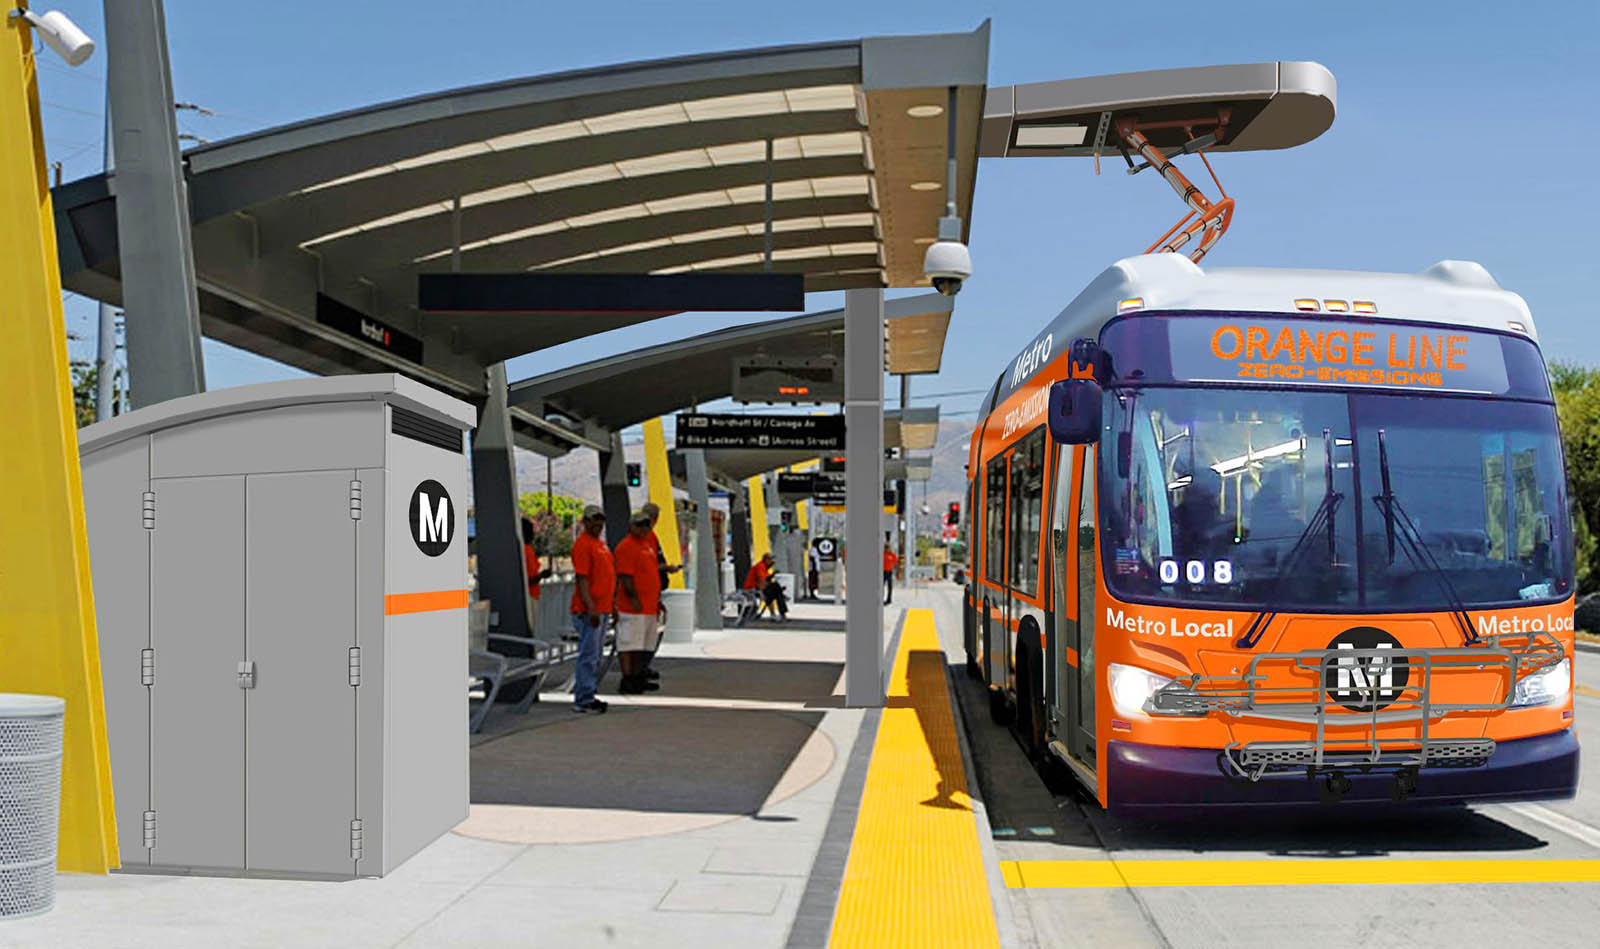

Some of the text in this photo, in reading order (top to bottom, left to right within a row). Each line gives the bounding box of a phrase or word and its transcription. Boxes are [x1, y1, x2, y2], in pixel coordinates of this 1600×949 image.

[1010, 333, 1053, 389] Metro
[1210, 325, 1469, 371] ORANGE LINE
[1237, 362, 1444, 386] ZERO-EMISSIONS
[1001, 378, 1055, 441] ZERO-EMISSION
[419, 492, 448, 543] M
[1106, 607, 1233, 638] Metro Local
[1478, 615, 1545, 635] Metro
[1337, 643, 1393, 696] M
